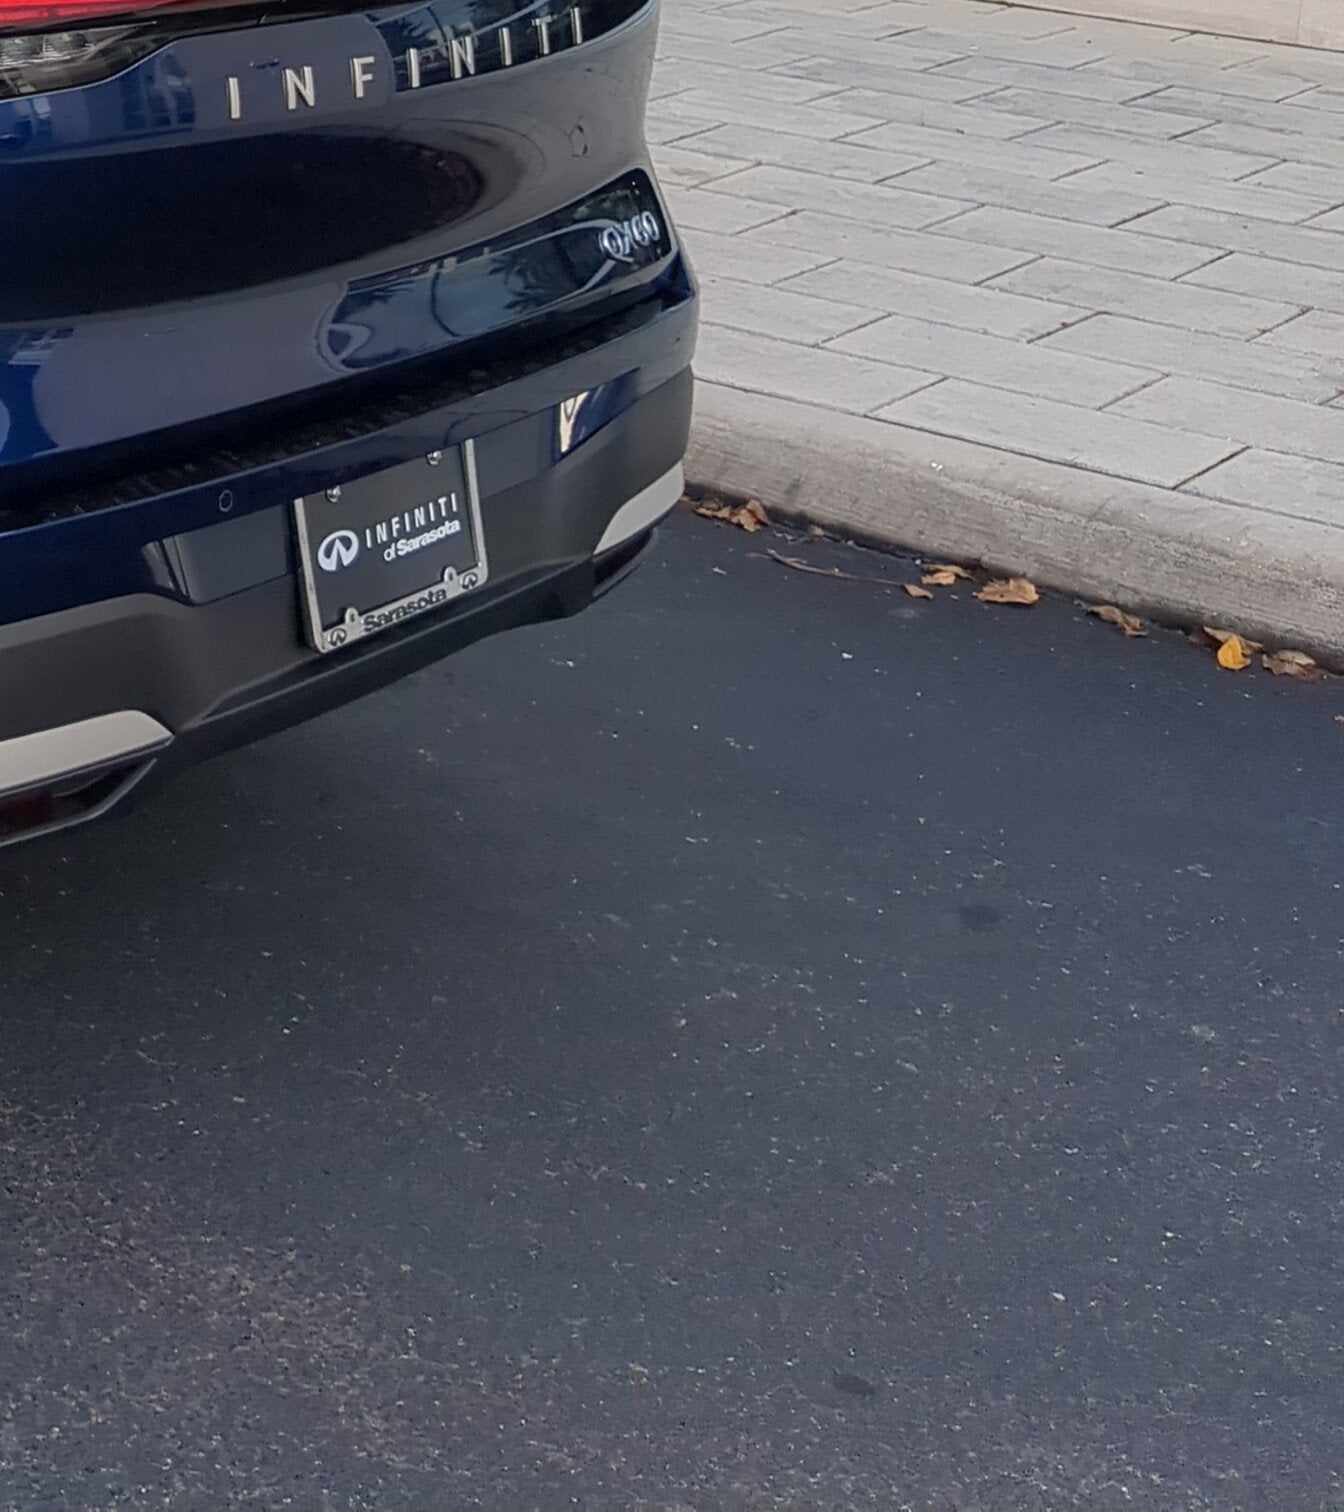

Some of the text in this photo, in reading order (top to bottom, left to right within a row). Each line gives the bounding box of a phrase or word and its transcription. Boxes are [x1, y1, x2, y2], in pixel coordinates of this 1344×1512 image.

[226, 6, 584, 120] INFINITI
[601, 210, 660, 263] QX60
[365, 492, 458, 549] INFINITI
[383, 519, 461, 562] of Sarasota
[362, 587, 448, 633] Sarasota
